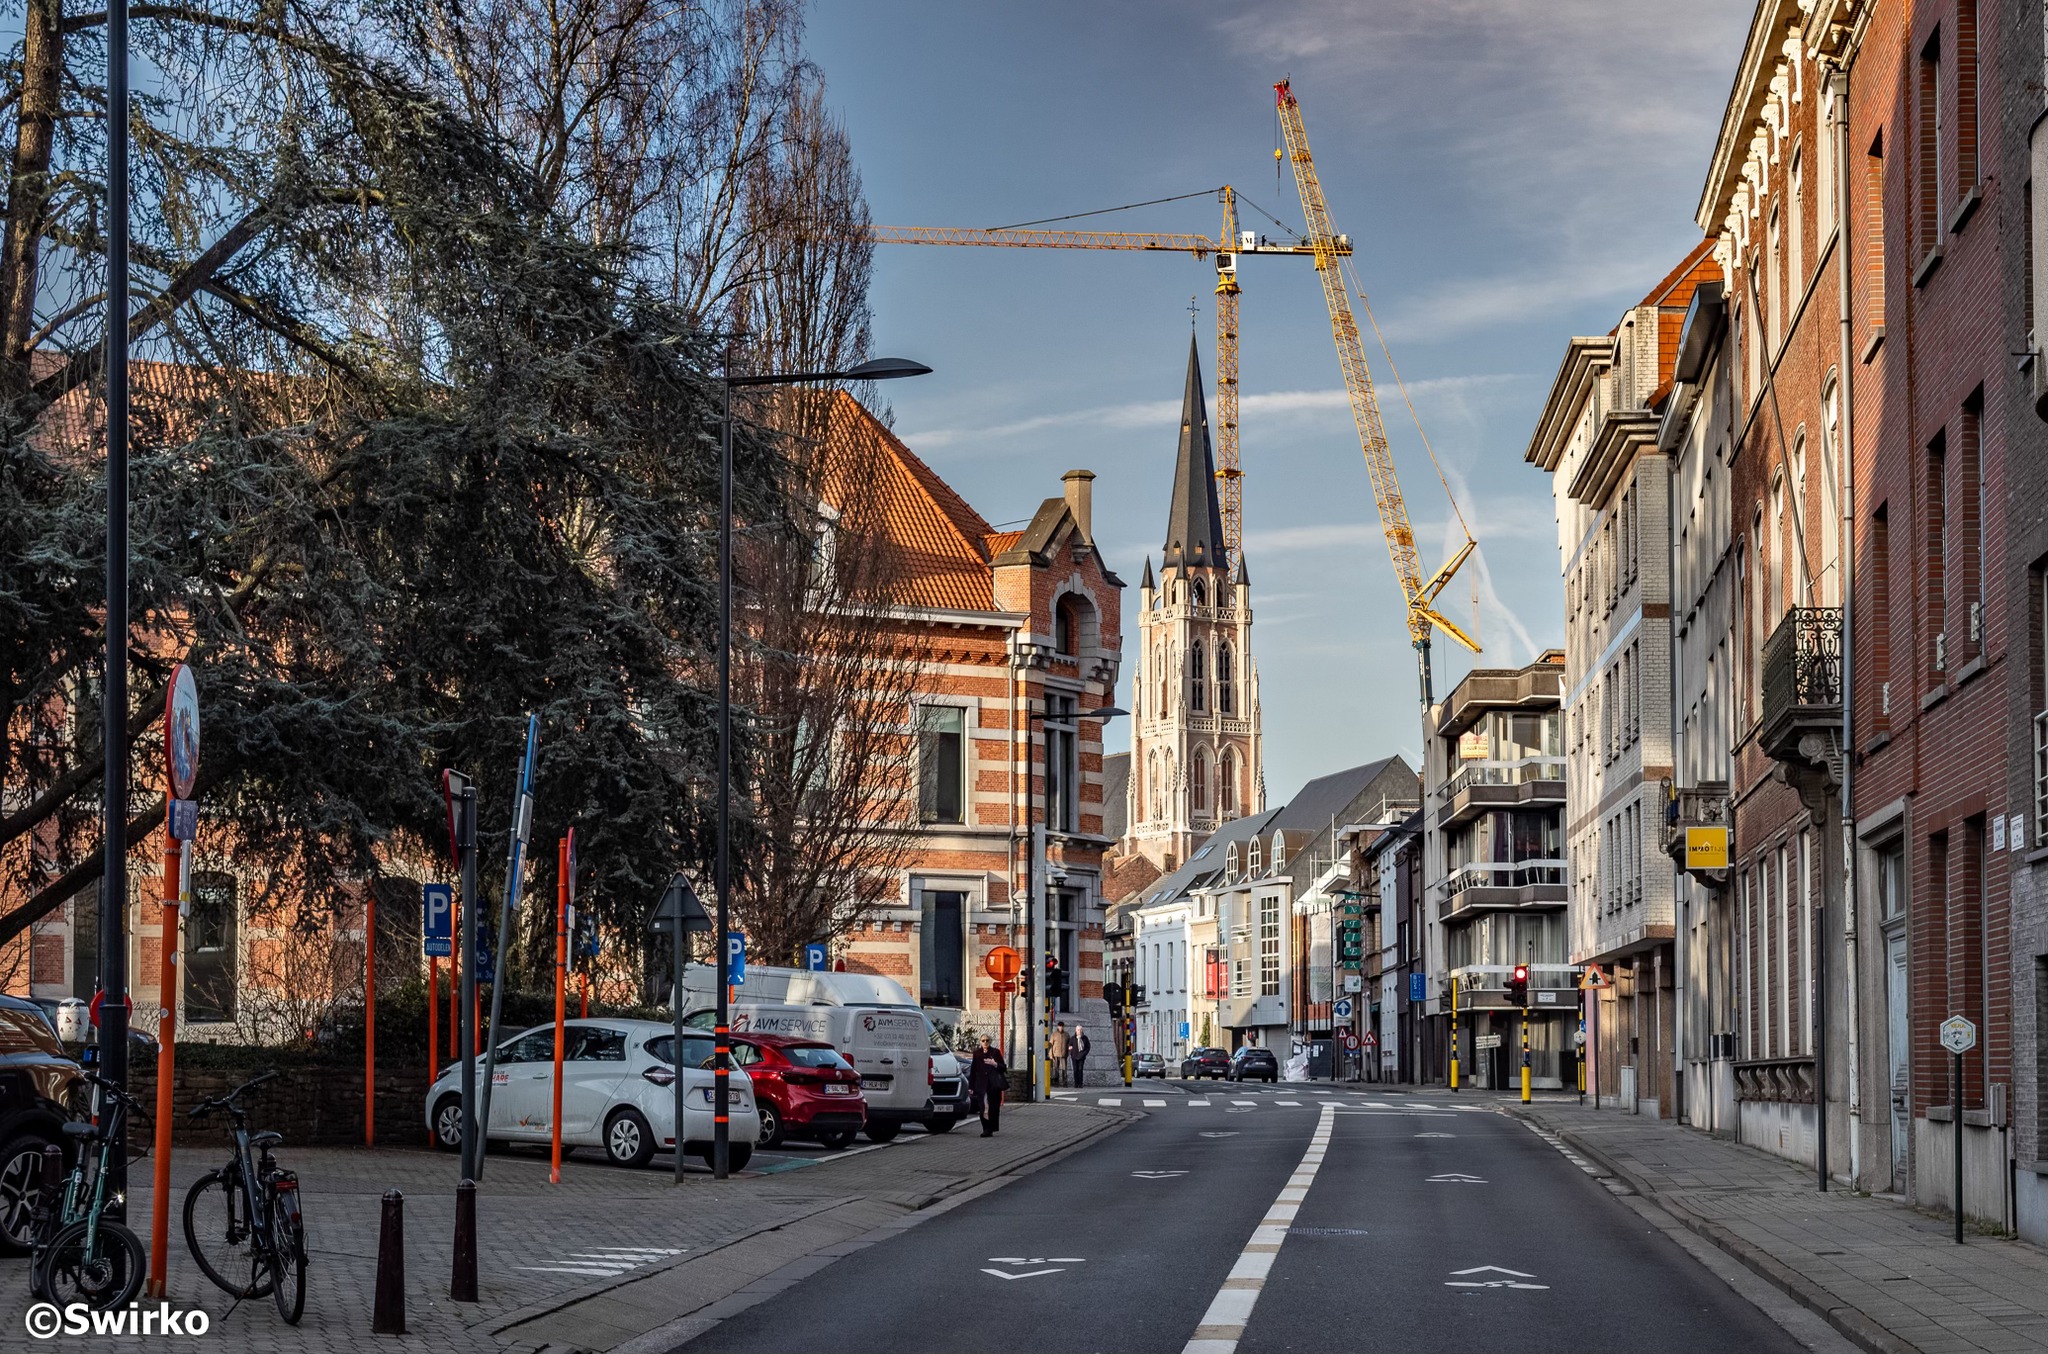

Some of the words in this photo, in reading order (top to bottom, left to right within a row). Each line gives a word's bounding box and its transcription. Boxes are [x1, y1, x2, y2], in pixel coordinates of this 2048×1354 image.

[429, 891, 448, 929] P
[426, 942, 451, 952] AUTODELEN
[728, 938, 742, 965] P
[809, 949, 823, 971] P
[753, 1018, 779, 1030] AVM
[780, 1019, 826, 1033] SERVICE
[877, 1018, 893, 1026] AVM
[894, 1019, 920, 1028] SERVICE
